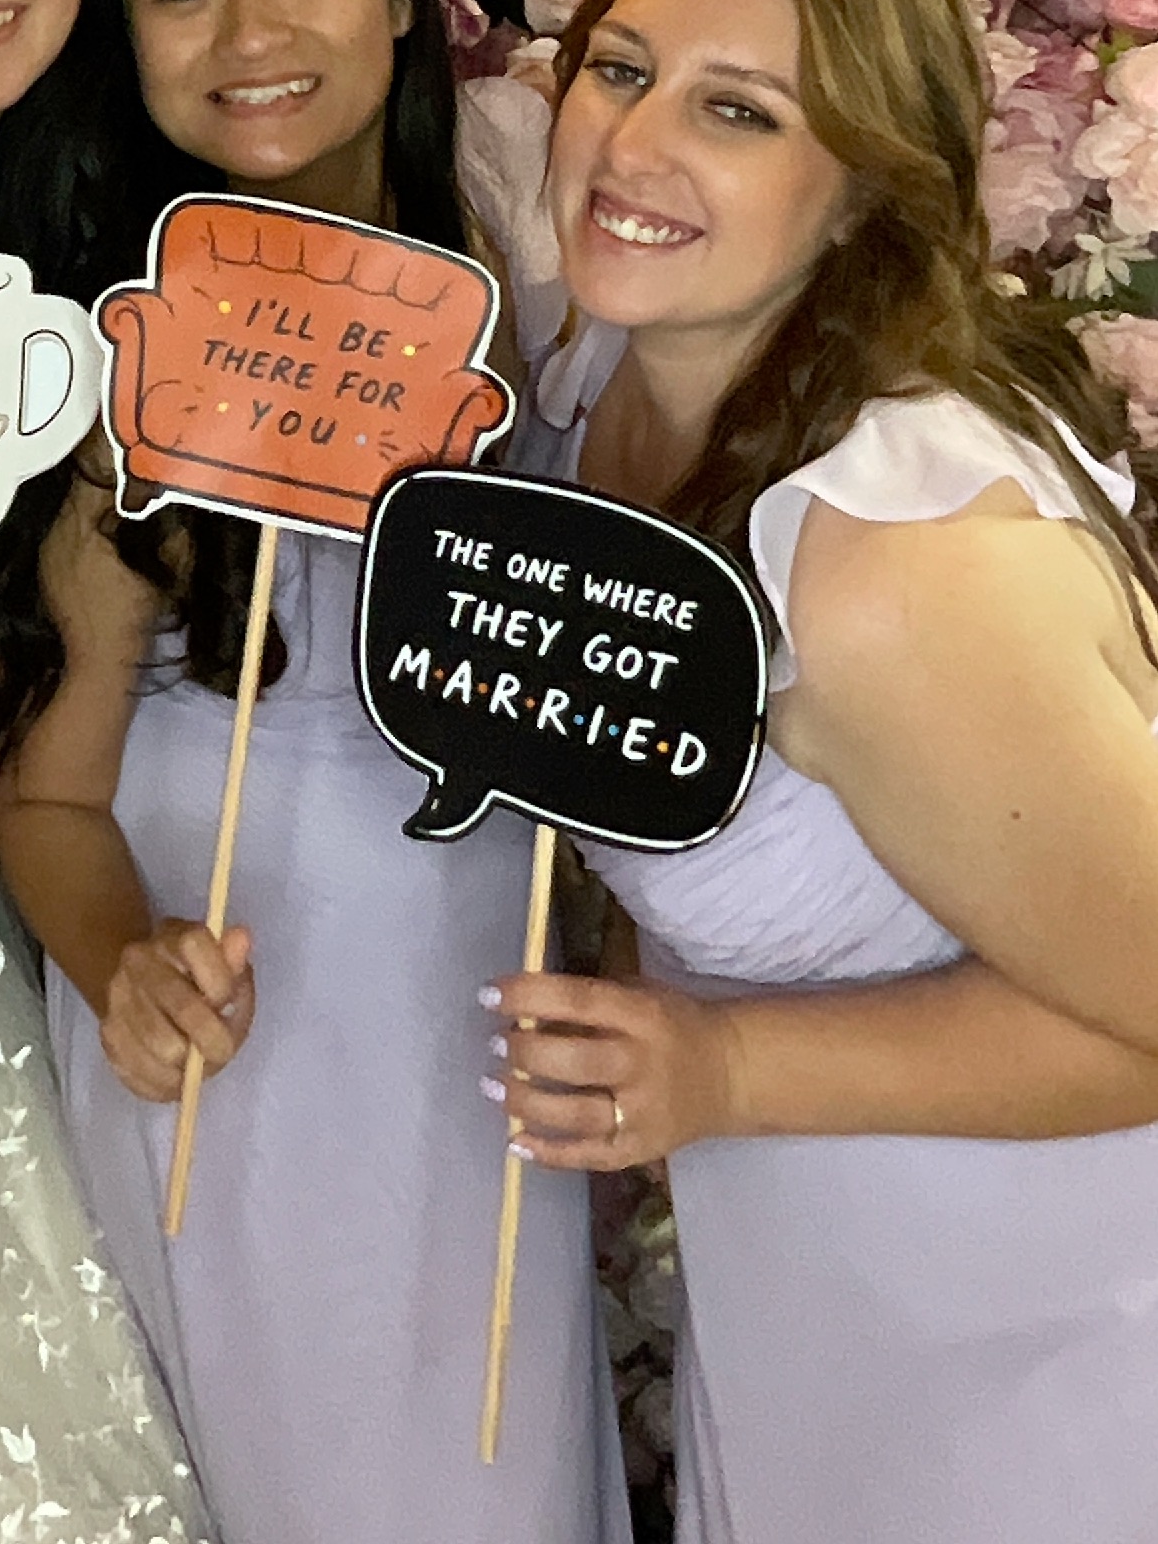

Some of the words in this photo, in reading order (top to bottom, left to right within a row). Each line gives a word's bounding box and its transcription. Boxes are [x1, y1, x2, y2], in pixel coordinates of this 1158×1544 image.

[245, 299, 313, 341] I'LL
[339, 321, 392, 358] BE
[203, 339, 317, 389] THERE
[335, 370, 407, 413] FOR
[251, 398, 338, 446] YOU
[434, 529, 494, 572] THE
[506, 554, 571, 593] ONE
[584, 572, 699, 632] WHERE
[447, 590, 564, 656] THEY
[583, 633, 679, 690] GOT
